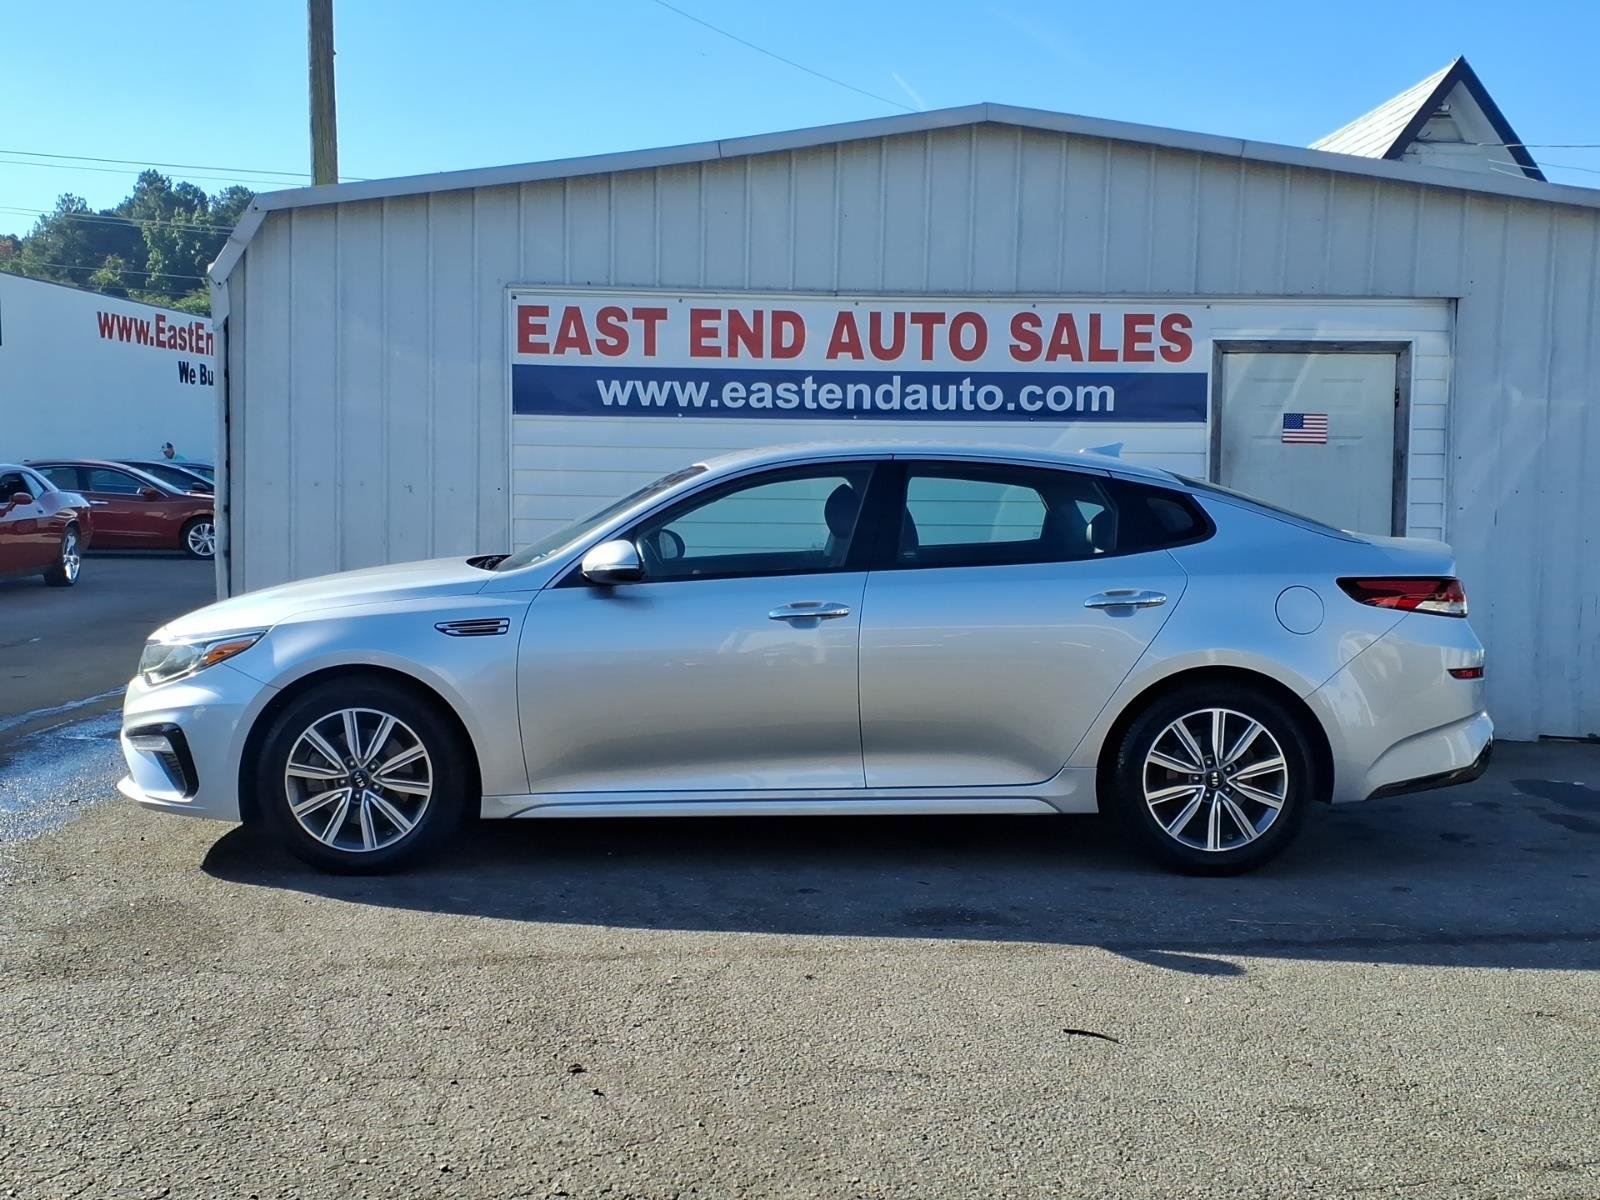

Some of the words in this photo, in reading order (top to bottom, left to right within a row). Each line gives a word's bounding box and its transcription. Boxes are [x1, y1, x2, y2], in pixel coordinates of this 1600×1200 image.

[517, 305, 667, 357] EAST
[690, 309, 806, 360] END
[826, 311, 988, 362] AUTO
[1009, 312, 1194, 364] SALES
[178, 361, 196, 385] We
[596, 375, 1116, 413] www.eastendauto.com
